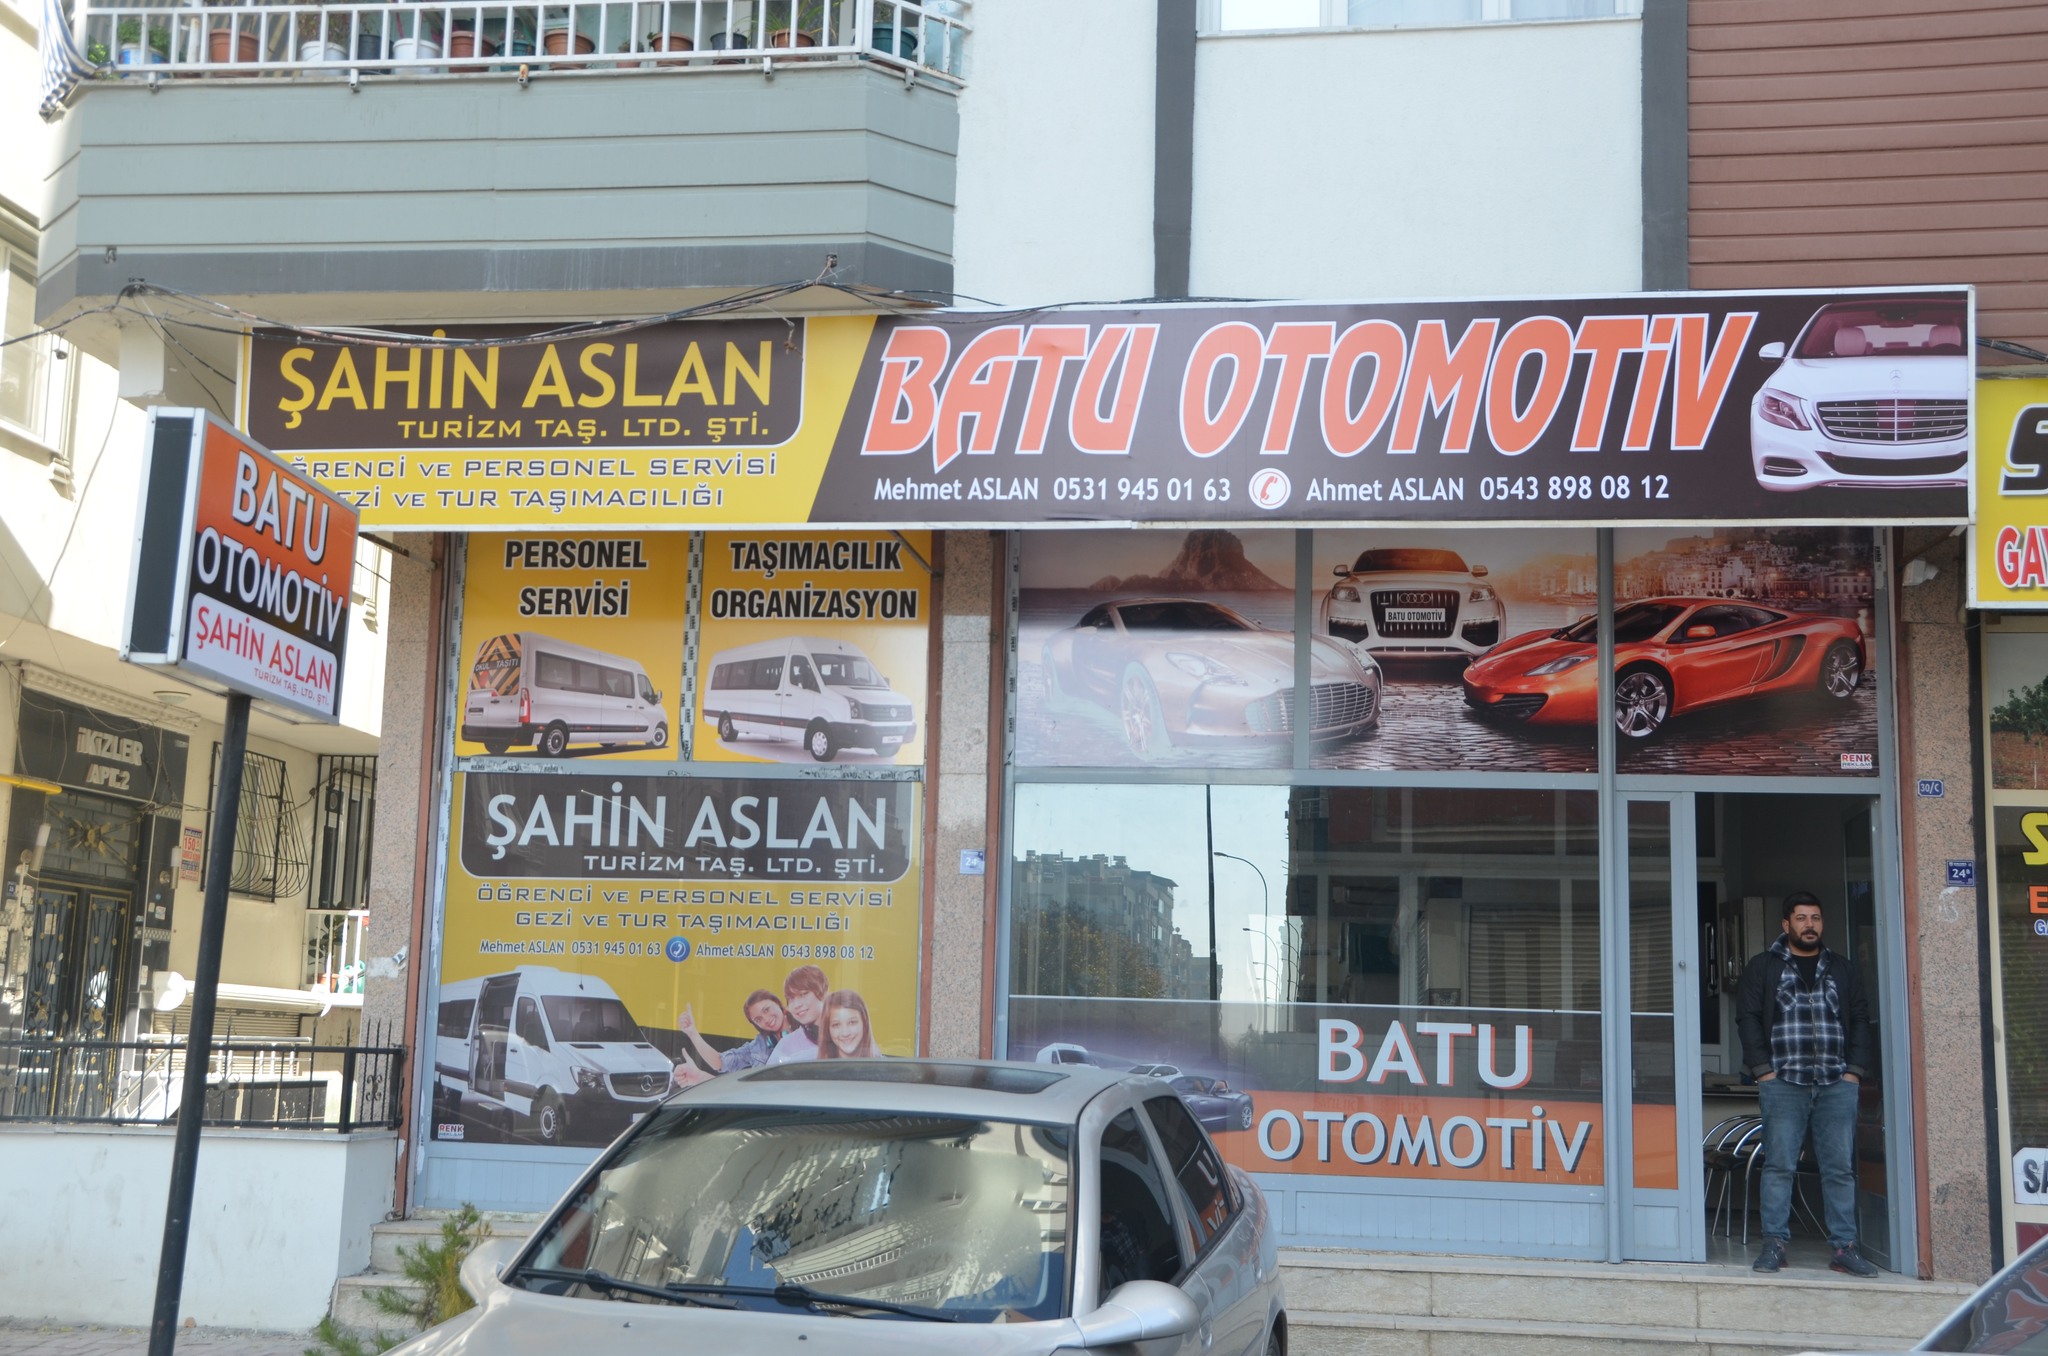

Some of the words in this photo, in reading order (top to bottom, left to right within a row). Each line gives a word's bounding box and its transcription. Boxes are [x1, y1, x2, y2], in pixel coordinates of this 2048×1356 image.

[278, 329, 499, 429] ŞAHİN
[522, 341, 772, 409] ASLAN
[861, 324, 1160, 473] BATU
[1179, 312, 1759, 457] OTOMOTİV
[398, 414, 521, 439] TURİZM
[535, 418, 607, 444] TAŞ.
[622, 417, 691, 437] LTD.
[706, 411, 769, 442] ŞTİ.
[419, 462, 452, 478] VE
[464, 458, 635, 478] PERSONEL
[650, 452, 777, 476] SERVİSİ
[394, 492, 425, 508] VE
[437, 490, 497, 507] TUR
[510, 483, 723, 513] TAŞIMACILIĞI
[874, 477, 961, 500] Mehmet
[968, 478, 1039, 500] ASLAN
[1053, 478, 1107, 500] 0531
[1117, 478, 1159, 501] 945
[1166, 478, 1193, 501] 01
[1203, 478, 1231, 501] 63
[1307, 477, 1383, 501] Ahmet
[1389, 477, 1464, 500] ASLAN
[1480, 476, 1540, 500] 0543
[1548, 476, 1593, 500] 898
[1600, 475, 1631, 499] 08
[1640, 474, 1670, 499] 12
[232, 449, 330, 564] BATU
[504, 540, 648, 570] PERSONEL
[730, 541, 902, 577] TAŞIMACILIK
[198, 526, 343, 643] OTOMOTİV
[519, 581, 630, 616] SERVİSİ
[711, 583, 918, 619] ORGANİZASYON
[1387, 610, 1406, 621] BATU
[1407, 609, 1442, 621] OTOMOTİV
[196, 605, 265, 665] ŞAHİN
[269, 639, 332, 693] ASLAN
[1842, 754, 1872, 762] RENK
[1920, 782, 1940, 794] 30/C
[487, 781, 666, 859] ŞAHİN
[685, 796, 886, 850] ASLAN
[584, 851, 685, 872] TURİZM
[695, 857, 754, 877] TAŞ.
[766, 857, 821, 873] LTD.
[834, 852, 884, 878] ŞTİ.
[477, 883, 592, 904] ÖĞRENCİ
[603, 891, 629, 904] VE
[640, 890, 778, 906] PERSONEL
[790, 888, 892, 907] SERVİSİ
[516, 907, 572, 927] GEZİ
[583, 915, 608, 928] VE
[618, 913, 667, 928] TUR
[678, 910, 850, 933] TAŞIMACILIĞI
[480, 939, 525, 953] Mehmet
[528, 940, 565, 954] ASLAN
[571, 941, 599, 955] 0531
[604, 941, 625, 955] 945
[628, 942, 642, 955] 01
[647, 943, 660, 955] 63
[696, 943, 733, 957] Ahmet
[737, 944, 774, 958] ASLAN
[781, 944, 810, 958] 0543
[814, 945, 836, 958] 898
[840, 946, 854, 959] 08
[859, 946, 873, 959] 12
[1318, 1019, 1532, 1089] BATU
[439, 1123, 465, 1133] RENK
[1257, 1106, 1592, 1172] OTOMOTİV
